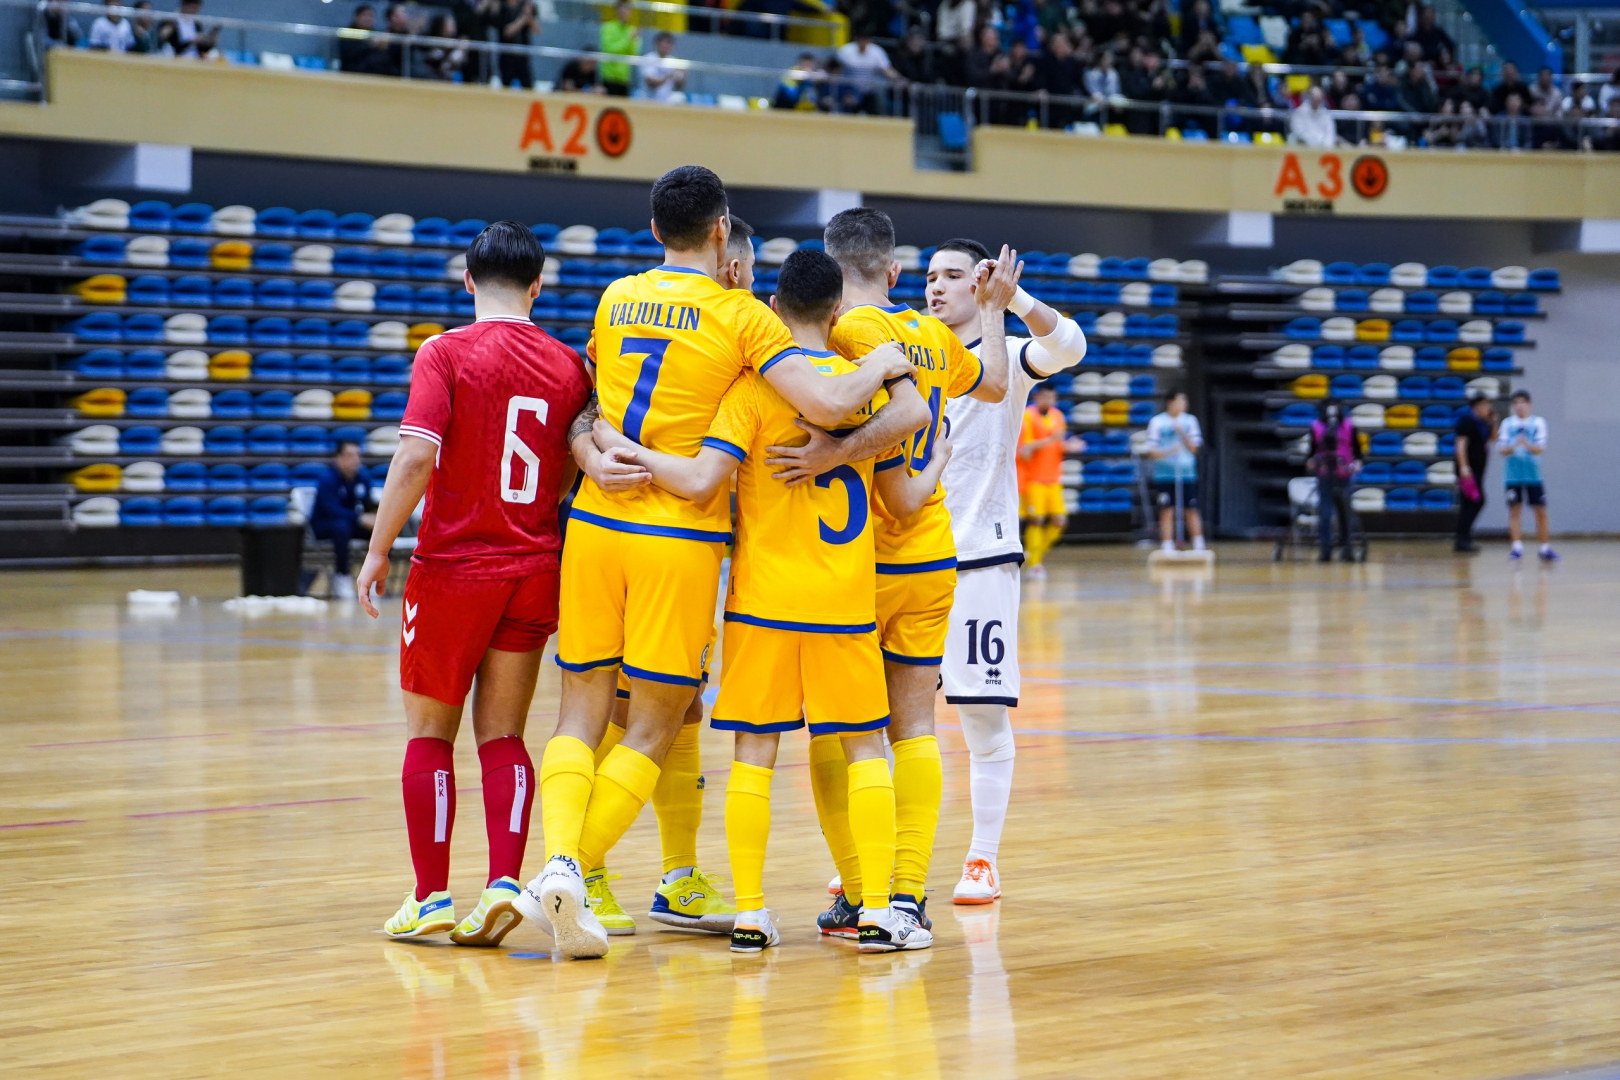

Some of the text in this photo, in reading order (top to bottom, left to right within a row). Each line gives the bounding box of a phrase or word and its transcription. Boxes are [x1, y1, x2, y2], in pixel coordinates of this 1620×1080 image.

[519, 99, 588, 155] A2
[1274, 152, 1343, 200] A3
[609, 301, 701, 331] VALIULLIN
[619, 337, 673, 447] 7
[500, 395, 549, 505] 6
[964, 619, 1005, 665] 16
[733, 932, 762, 940] TOP-FLEX
